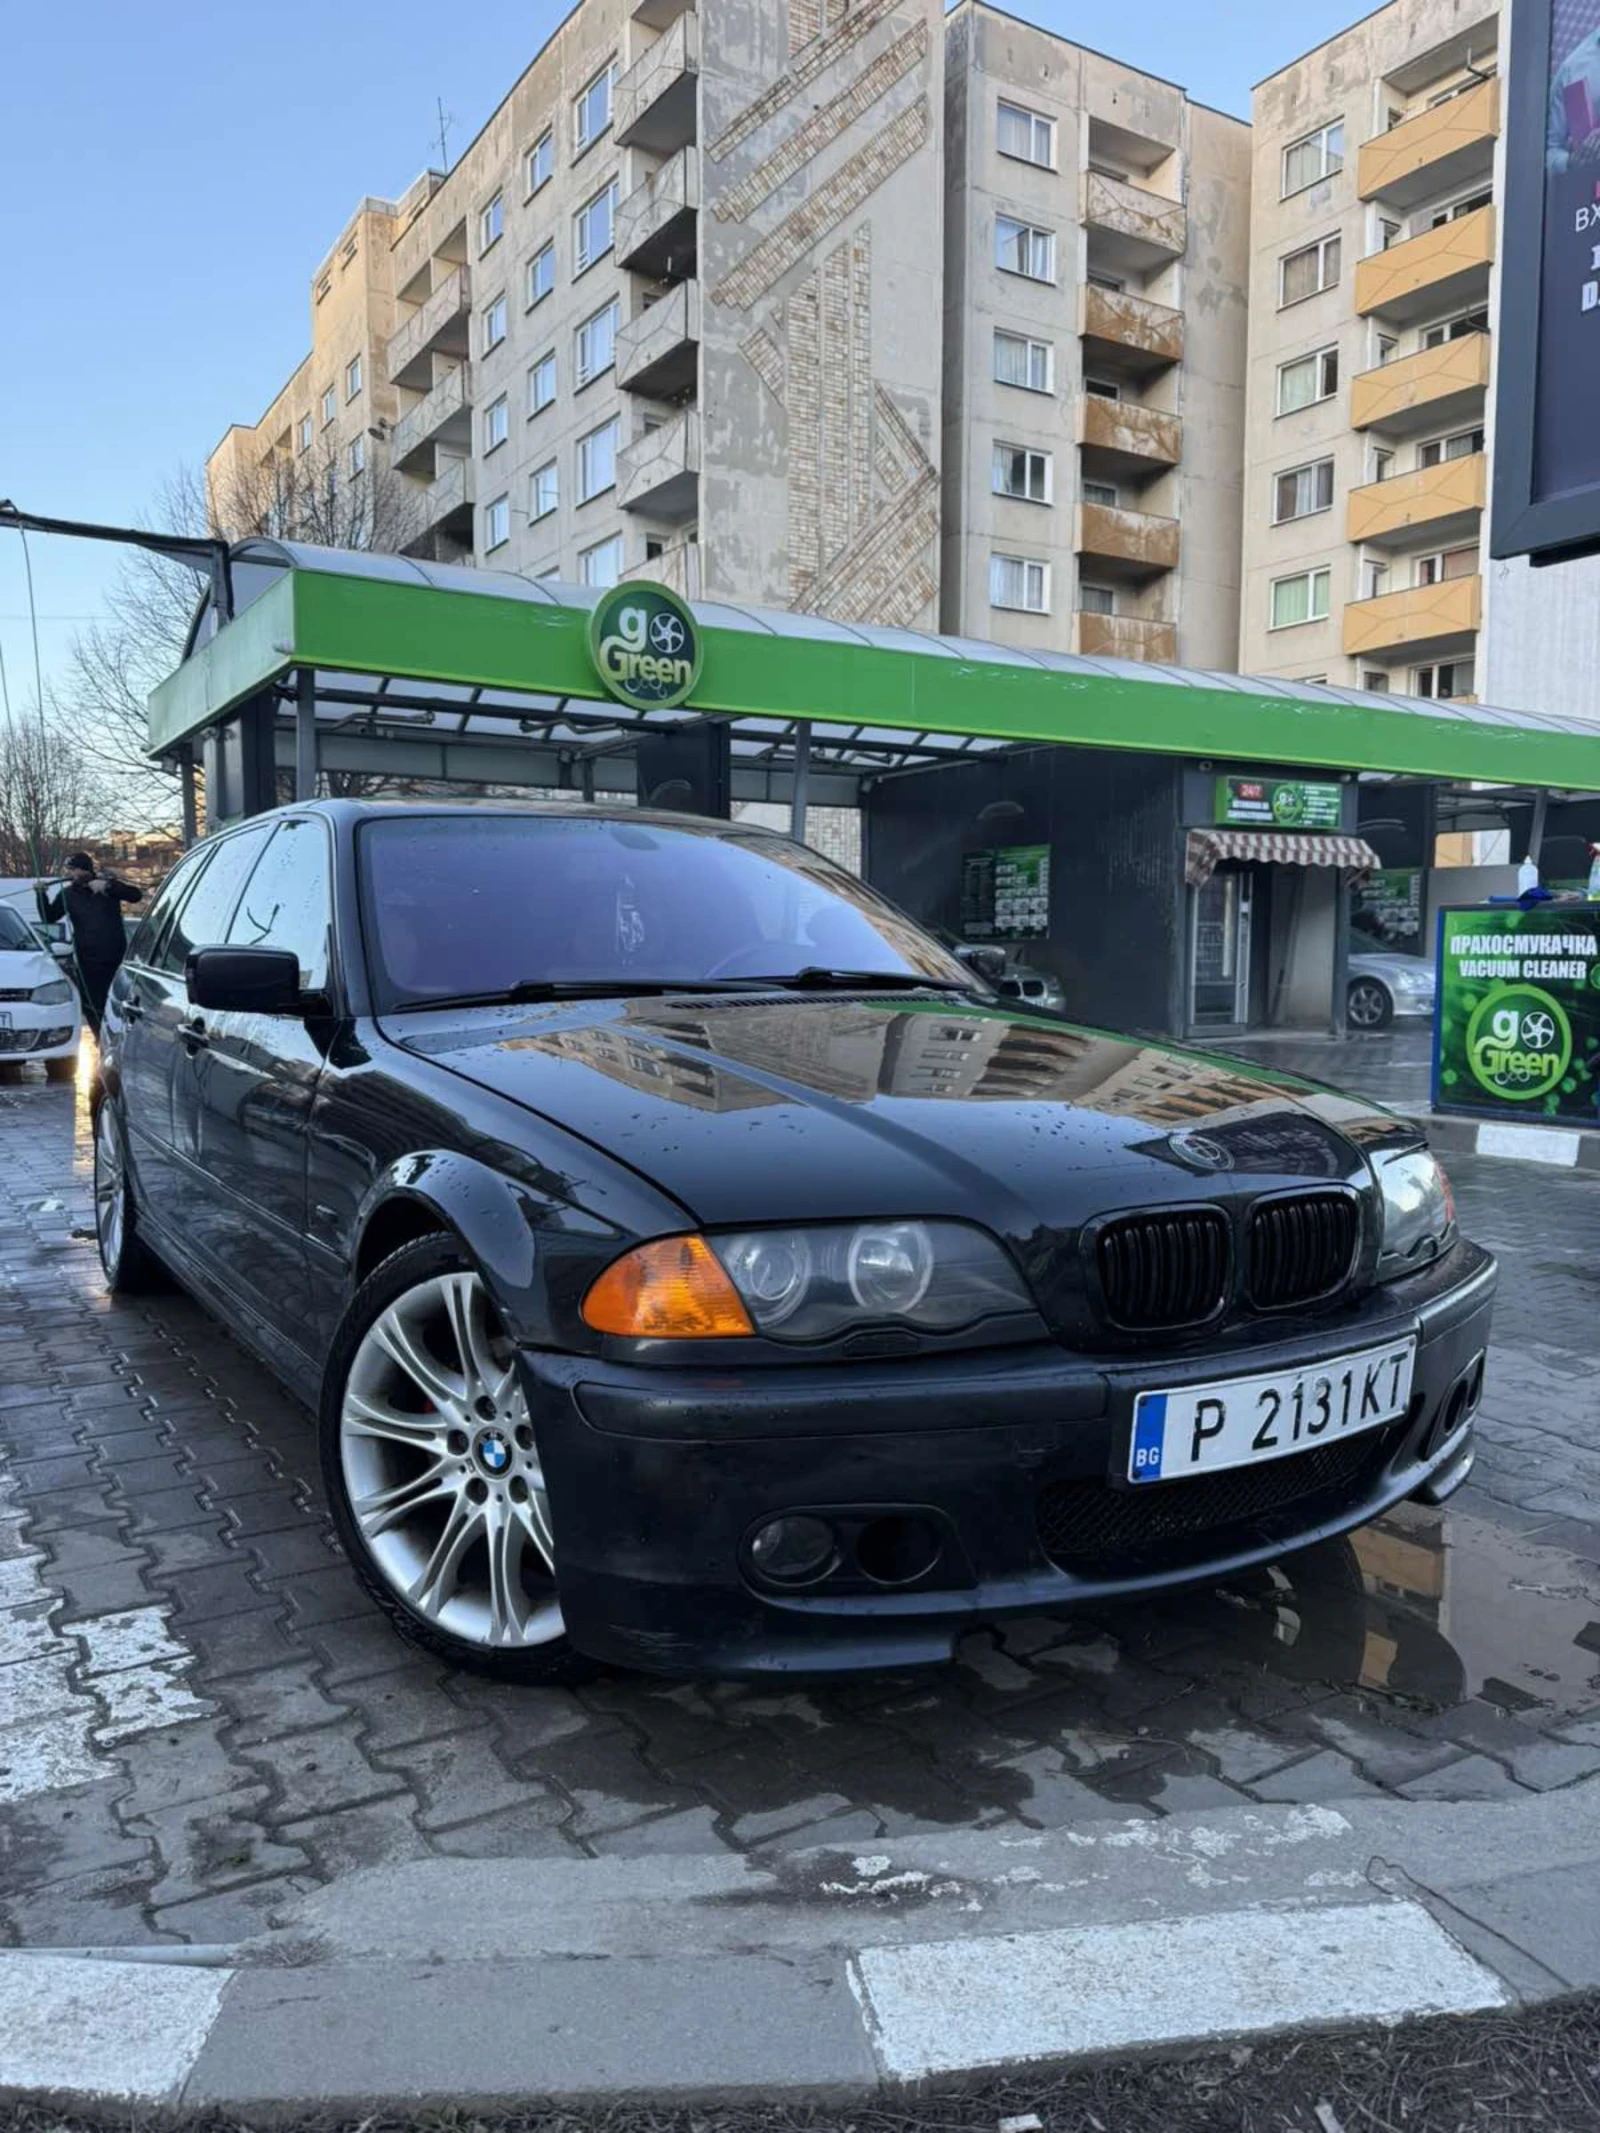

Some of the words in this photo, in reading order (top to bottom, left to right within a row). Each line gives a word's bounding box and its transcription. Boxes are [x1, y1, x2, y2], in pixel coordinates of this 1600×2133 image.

[600, 636, 692, 684] Green
[1450, 934, 1597, 956] ПРАХОСМУКАЧКА
[1460, 960, 1520, 977] VACUUM
[1523, 960, 1587, 979] CLEANER
[1474, 1036, 1559, 1076] Green
[1190, 1398, 1225, 1462] P
[1136, 1448, 1160, 1467] BG
